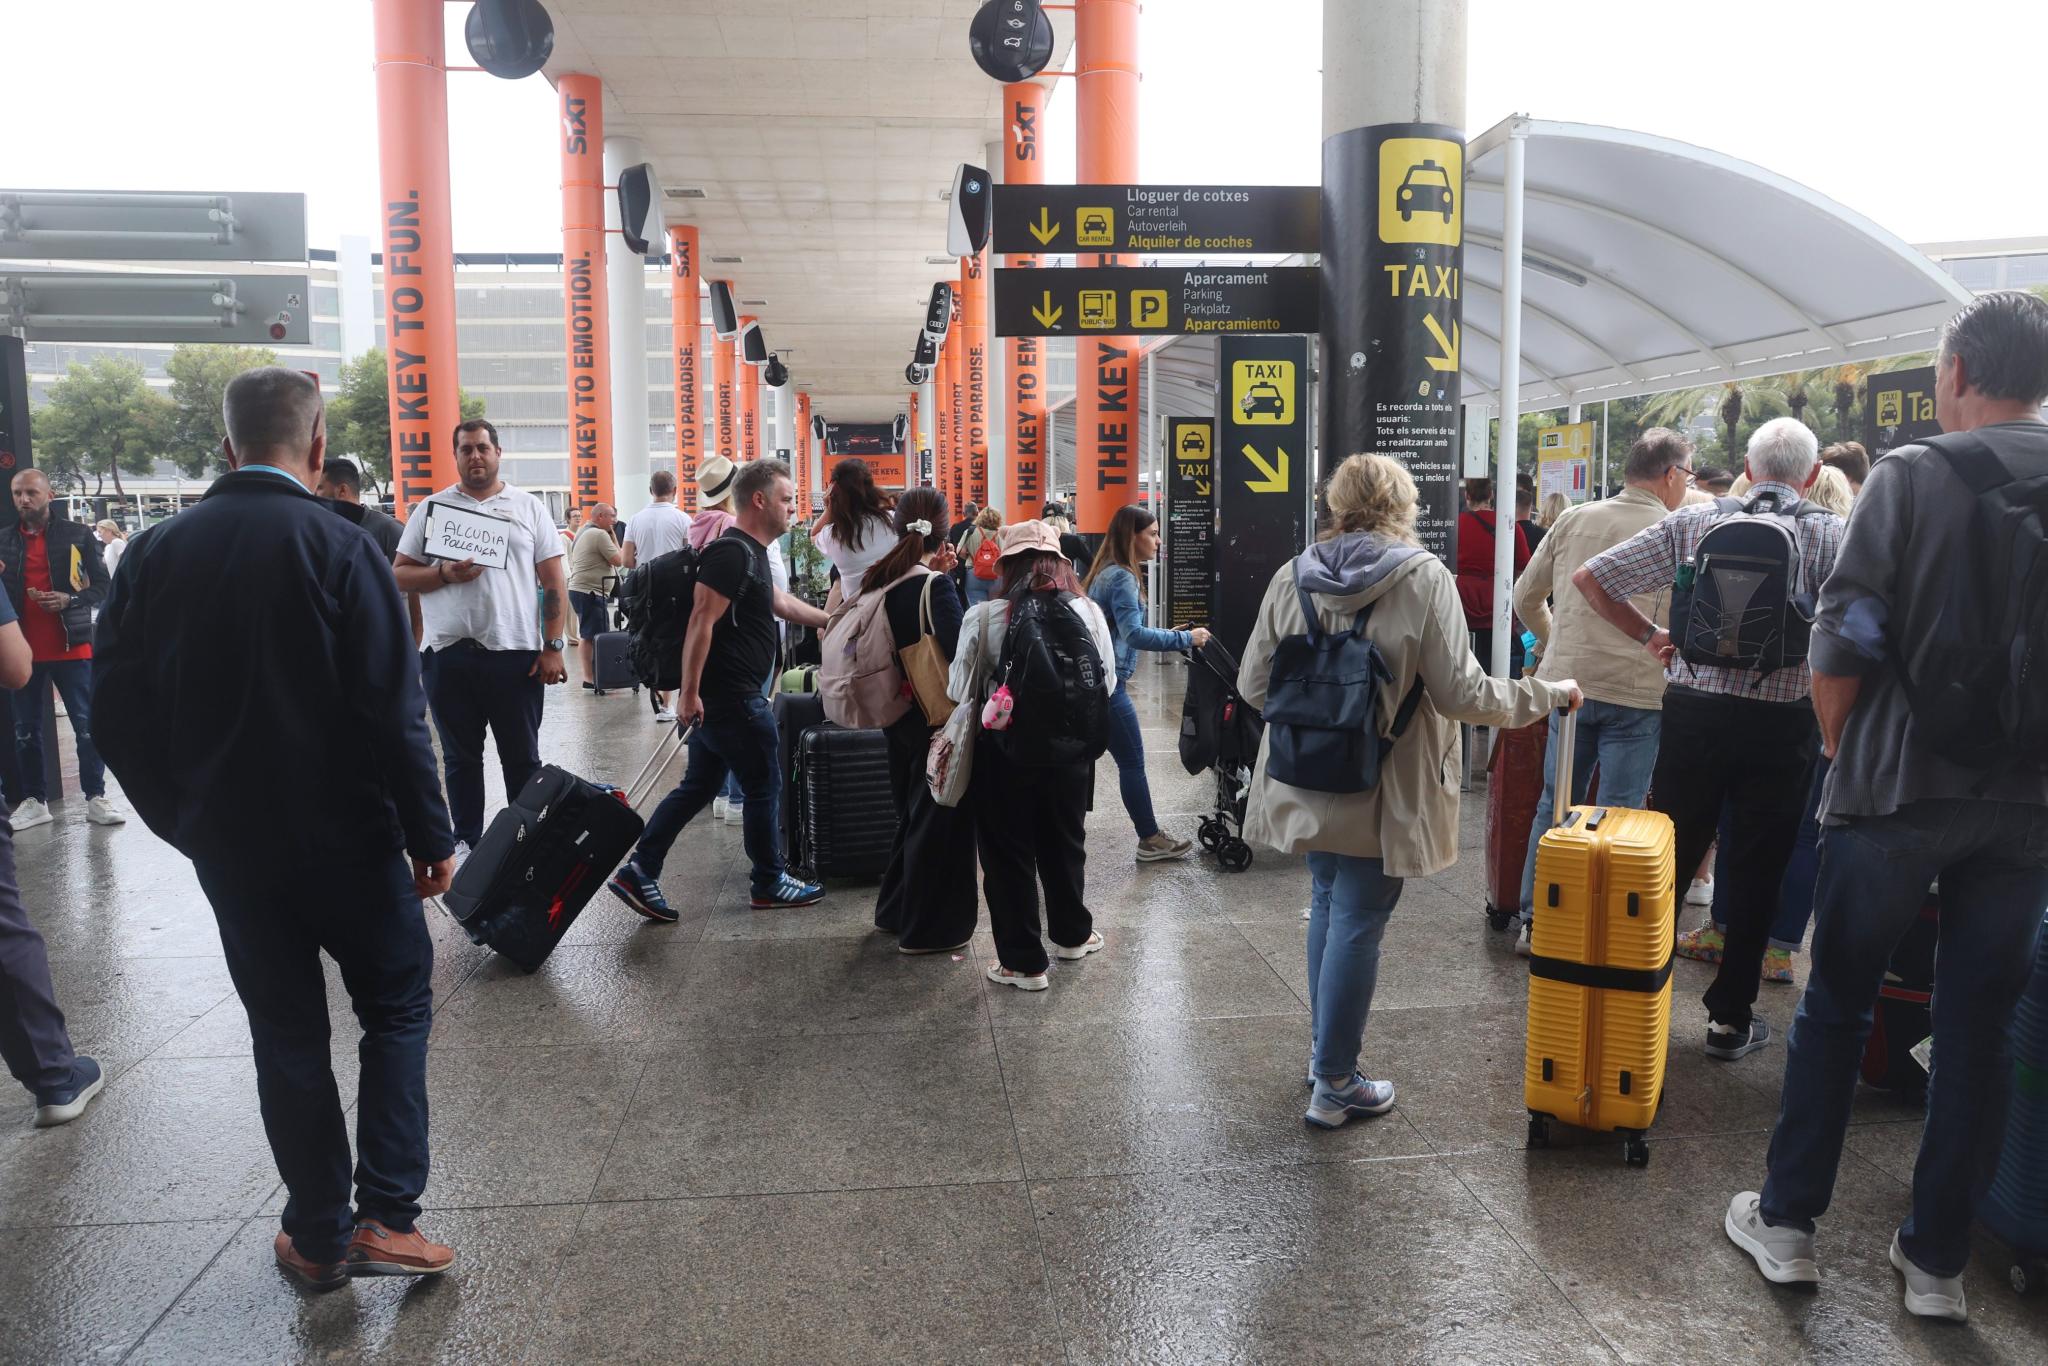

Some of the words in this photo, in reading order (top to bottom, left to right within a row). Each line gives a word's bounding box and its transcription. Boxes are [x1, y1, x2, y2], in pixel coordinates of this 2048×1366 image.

[1127, 188, 1180, 204] Lloguer
[1183, 188, 1200, 202] de
[1203, 190, 1250, 202] cotxes
[1127, 205, 1146, 217] Car
[1148, 204, 1179, 217] rental
[387, 190, 422, 276] FUN.
[1127, 219, 1187, 232] Autoverleih
[1078, 235, 1090, 243] CAR
[1091, 235, 1112, 243] RENTAL
[1127, 234, 1181, 250] Alquiler
[1183, 234, 1201, 248] de
[1204, 234, 1253, 248] coches
[1183, 271, 1269, 287] Aparcament
[1383, 264, 1459, 300] TAXI
[1183, 288, 1223, 301] Parking
[391, 287, 425, 337] TO
[570, 251, 594, 369] EMOTION.
[1140, 296, 1160, 322] P
[1183, 302, 1231, 316] Parkplatz
[1184, 317, 1281, 333] Aparcamiento
[1097, 342, 1128, 412] KEY
[1244, 364, 1283, 379] TAXI
[395, 348, 429, 420] KEY
[574, 375, 595, 407] TO
[680, 342, 694, 425] PARADISE.
[969, 342, 983, 425] PARADISE.
[1016, 373, 1037, 404] TO
[719, 380, 732, 444] COMFORT.
[1376, 403, 1388, 411] Es
[1389, 402, 1423, 411] recorda
[1431, 403, 1444, 412] tots
[1906, 391, 1935, 422] Ta
[745, 408, 753, 437] FREE.
[1376, 414, 1411, 423] usuaris:
[575, 413, 597, 459] KEY
[681, 428, 695, 449] TO
[970, 428, 984, 447] TO
[1017, 410, 1037, 455] KEY
[1376, 426, 1394, 435] Tots
[1396, 426, 1409, 435] els
[1411, 426, 1438, 435] serveis
[1439, 427, 1447, 435] de
[745, 438, 754, 461] FEEL
[1388, 438, 1433, 447] realitzaran
[1434, 438, 1448, 447] amb
[954, 447, 963, 463] TO
[1097, 423, 1128, 491] THE
[1410, 461, 1441, 470] vehicles
[399, 432, 433, 503] THE
[683, 454, 696, 483] KEY
[880, 467, 901, 475] KEYS.
[954, 466, 963, 488] KEY
[970, 451, 984, 484] KEY
[1178, 463, 1209, 476] TAXI
[1445, 473, 1451, 482] el
[577, 466, 599, 510] THE
[1017, 461, 1037, 505] THE
[683, 487, 697, 514] THE
[954, 489, 963, 516] THE
[1431, 519, 1444, 527] take
[1431, 542, 1440, 550] for
[1440, 542, 1445, 550] 5
[1438, 553, 1447, 561] the
[1077, 654, 1095, 689] KEEP
